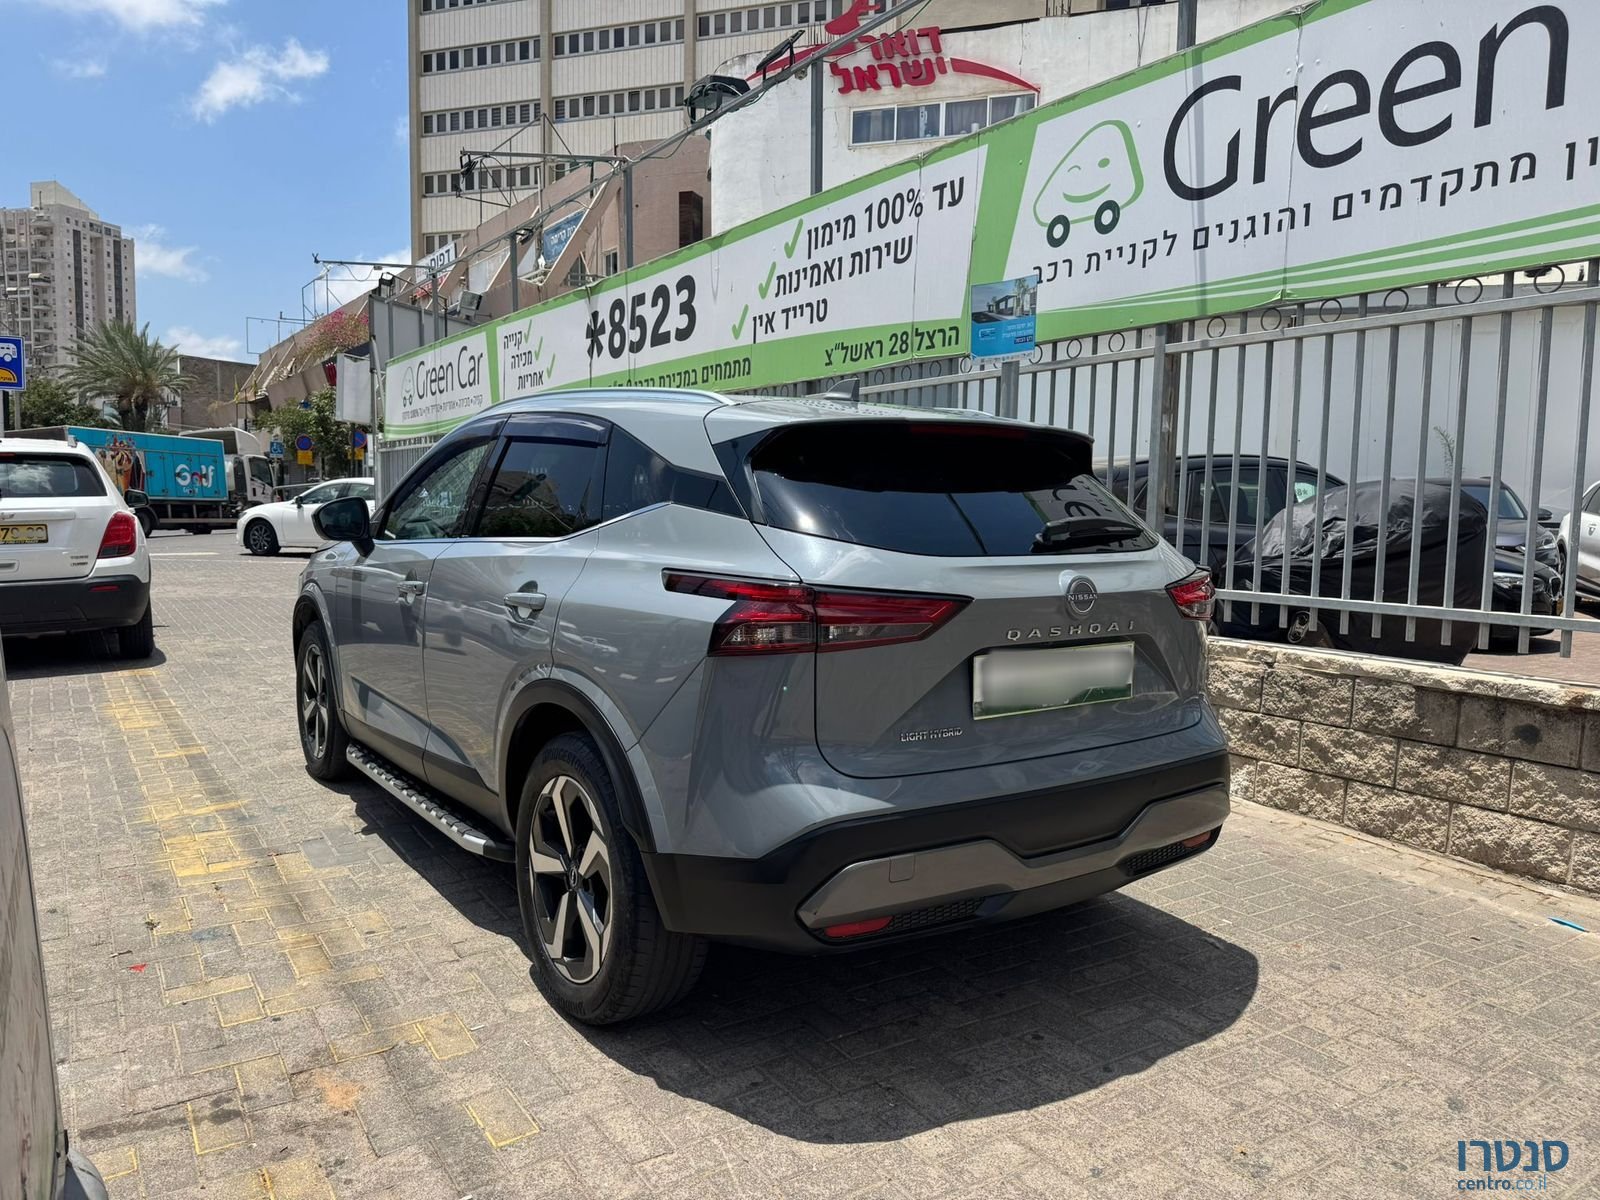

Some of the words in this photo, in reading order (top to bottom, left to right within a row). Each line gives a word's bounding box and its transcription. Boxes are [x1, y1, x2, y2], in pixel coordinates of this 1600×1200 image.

[857, 26, 942, 61] דואר
[829, 56, 948, 94] ישראל
[1163, 5, 1569, 201] Green
[932, 176, 965, 211] עד
[1332, 151, 1537, 221] מתקדמים
[864, 187, 923, 232] 100%
[1192, 202, 1311, 251] והוגנים
[807, 214, 856, 260] מימון
[1084, 229, 1178, 275] לקניית
[848, 235, 913, 278] שירות
[1032, 258, 1073, 285] רכב
[774, 256, 843, 298] ואמינות
[752, 310, 776, 344] אין
[781, 298, 828, 330] טרייד
[503, 330, 523, 350] קנייה
[888, 330, 909, 356] 28
[914, 325, 960, 351] הרצל
[416, 360, 454, 400] Green
[457, 345, 483, 389] Car
[511, 350, 533, 370] מכירה
[701, 357, 751, 384] מתמחים
[517, 370, 544, 390] אחריות
[1067, 593, 1098, 602] NISSAN
[900, 731, 928, 742] LIGHT
[929, 727, 963, 740] HYBRID
